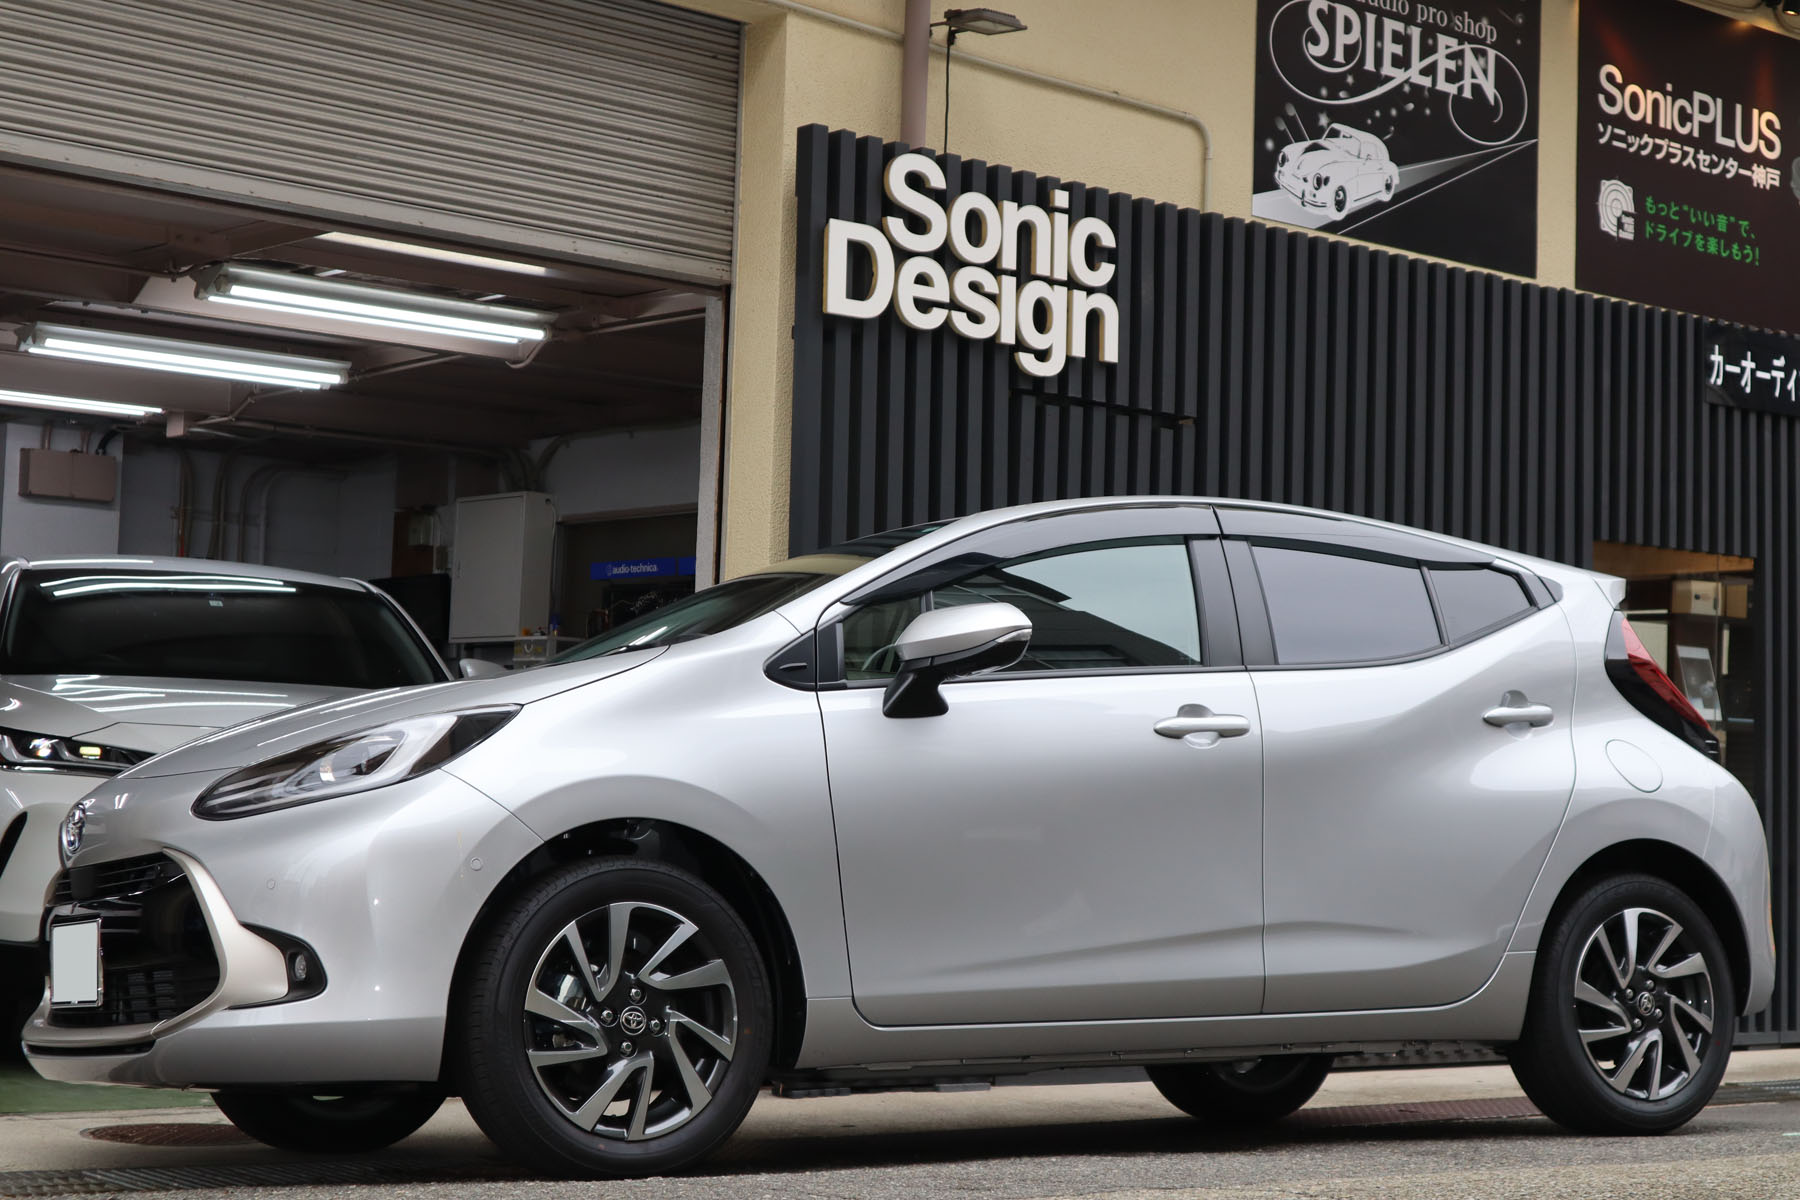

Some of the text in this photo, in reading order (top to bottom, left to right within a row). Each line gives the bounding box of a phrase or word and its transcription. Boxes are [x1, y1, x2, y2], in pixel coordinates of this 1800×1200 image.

[1306, 0, 1497, 107] SPIELEN
[1357, 0, 1498, 44] dio pro shop
[1598, 64, 1782, 160] SonicPLUS
[1598, 122, 1781, 191] ソニックプラスセンター神戸
[882, 153, 1117, 287] Sonic
[822, 217, 1119, 377] Design
[1710, 344, 1799, 402] カーオーディ
